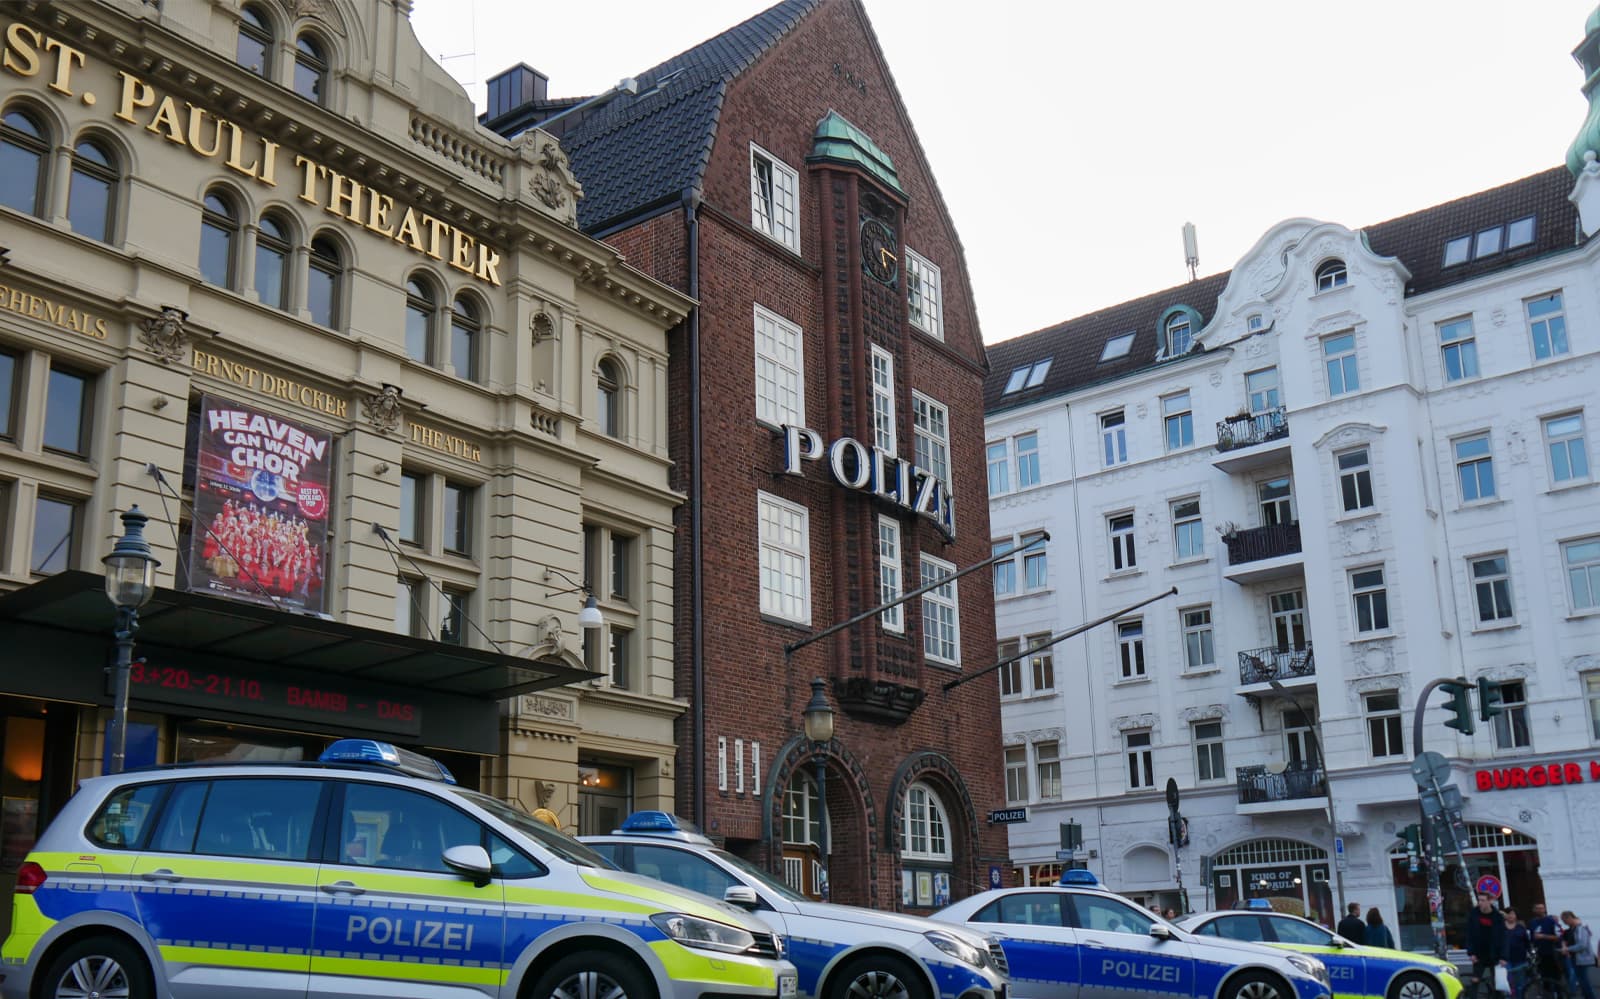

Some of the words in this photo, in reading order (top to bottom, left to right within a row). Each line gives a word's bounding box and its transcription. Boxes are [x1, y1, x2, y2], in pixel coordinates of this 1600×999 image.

[3, 21, 97, 106] ST.
[115, 71, 280, 188] PAULI
[296, 155, 502, 288] THEATER
[192, 349, 259, 389] ERNST
[261, 371, 347, 418] DRUCKER
[208, 410, 327, 460] HEAVEN
[223, 431, 261, 448] CAN
[264, 437, 310, 469] WAIT
[408, 422, 481, 463] THEATER
[231, 446, 300, 483] CHOR
[287, 687, 348, 712] BAMBI
[377, 700, 416, 720] DAS
[1475, 762, 1583, 791] BURGER
[994, 811, 1025, 820] POLIZEI
[1252, 872, 1276, 881] KING
[1279, 871, 1292, 880] OF
[346, 915, 475, 951] POLIZEI
[1101, 959, 1181, 983] POLIZEI
